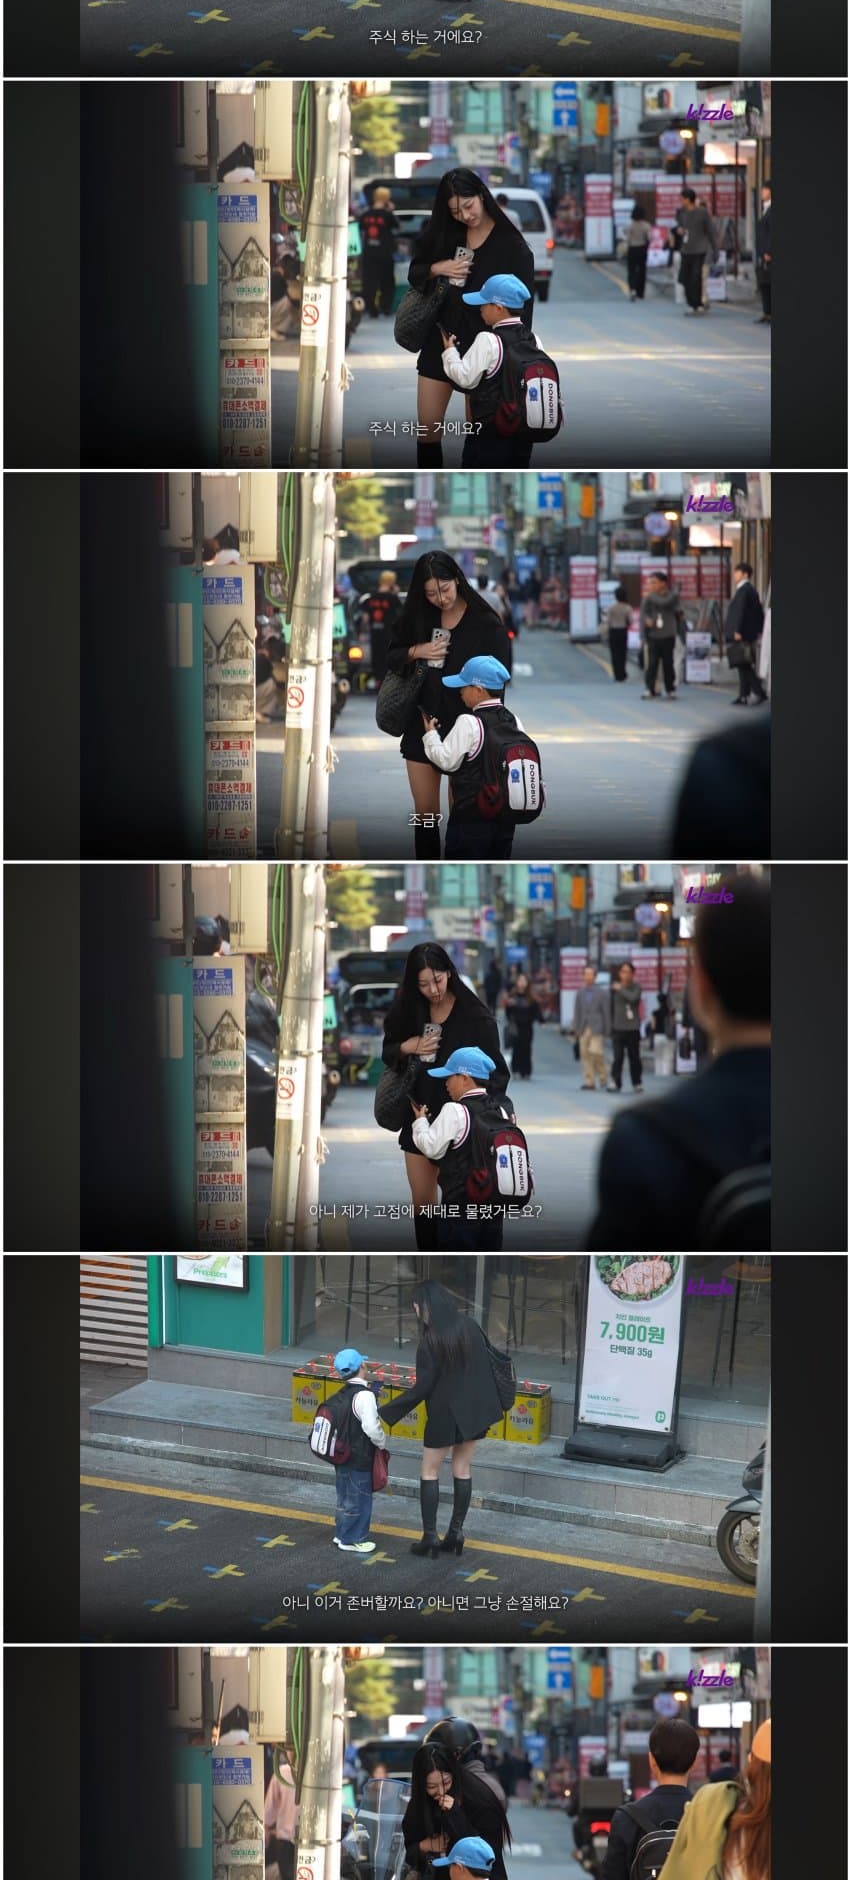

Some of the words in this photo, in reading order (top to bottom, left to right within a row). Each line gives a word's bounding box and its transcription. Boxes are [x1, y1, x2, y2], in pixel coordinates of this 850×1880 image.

[529, 763, 537, 806] DONGBUK
[515, 1150, 525, 1192] DONGBUK
[600, 1320, 665, 1345] 7,900원
[610, 1344, 635, 1355] 단백질
[637, 1347, 652, 1358] 35g
